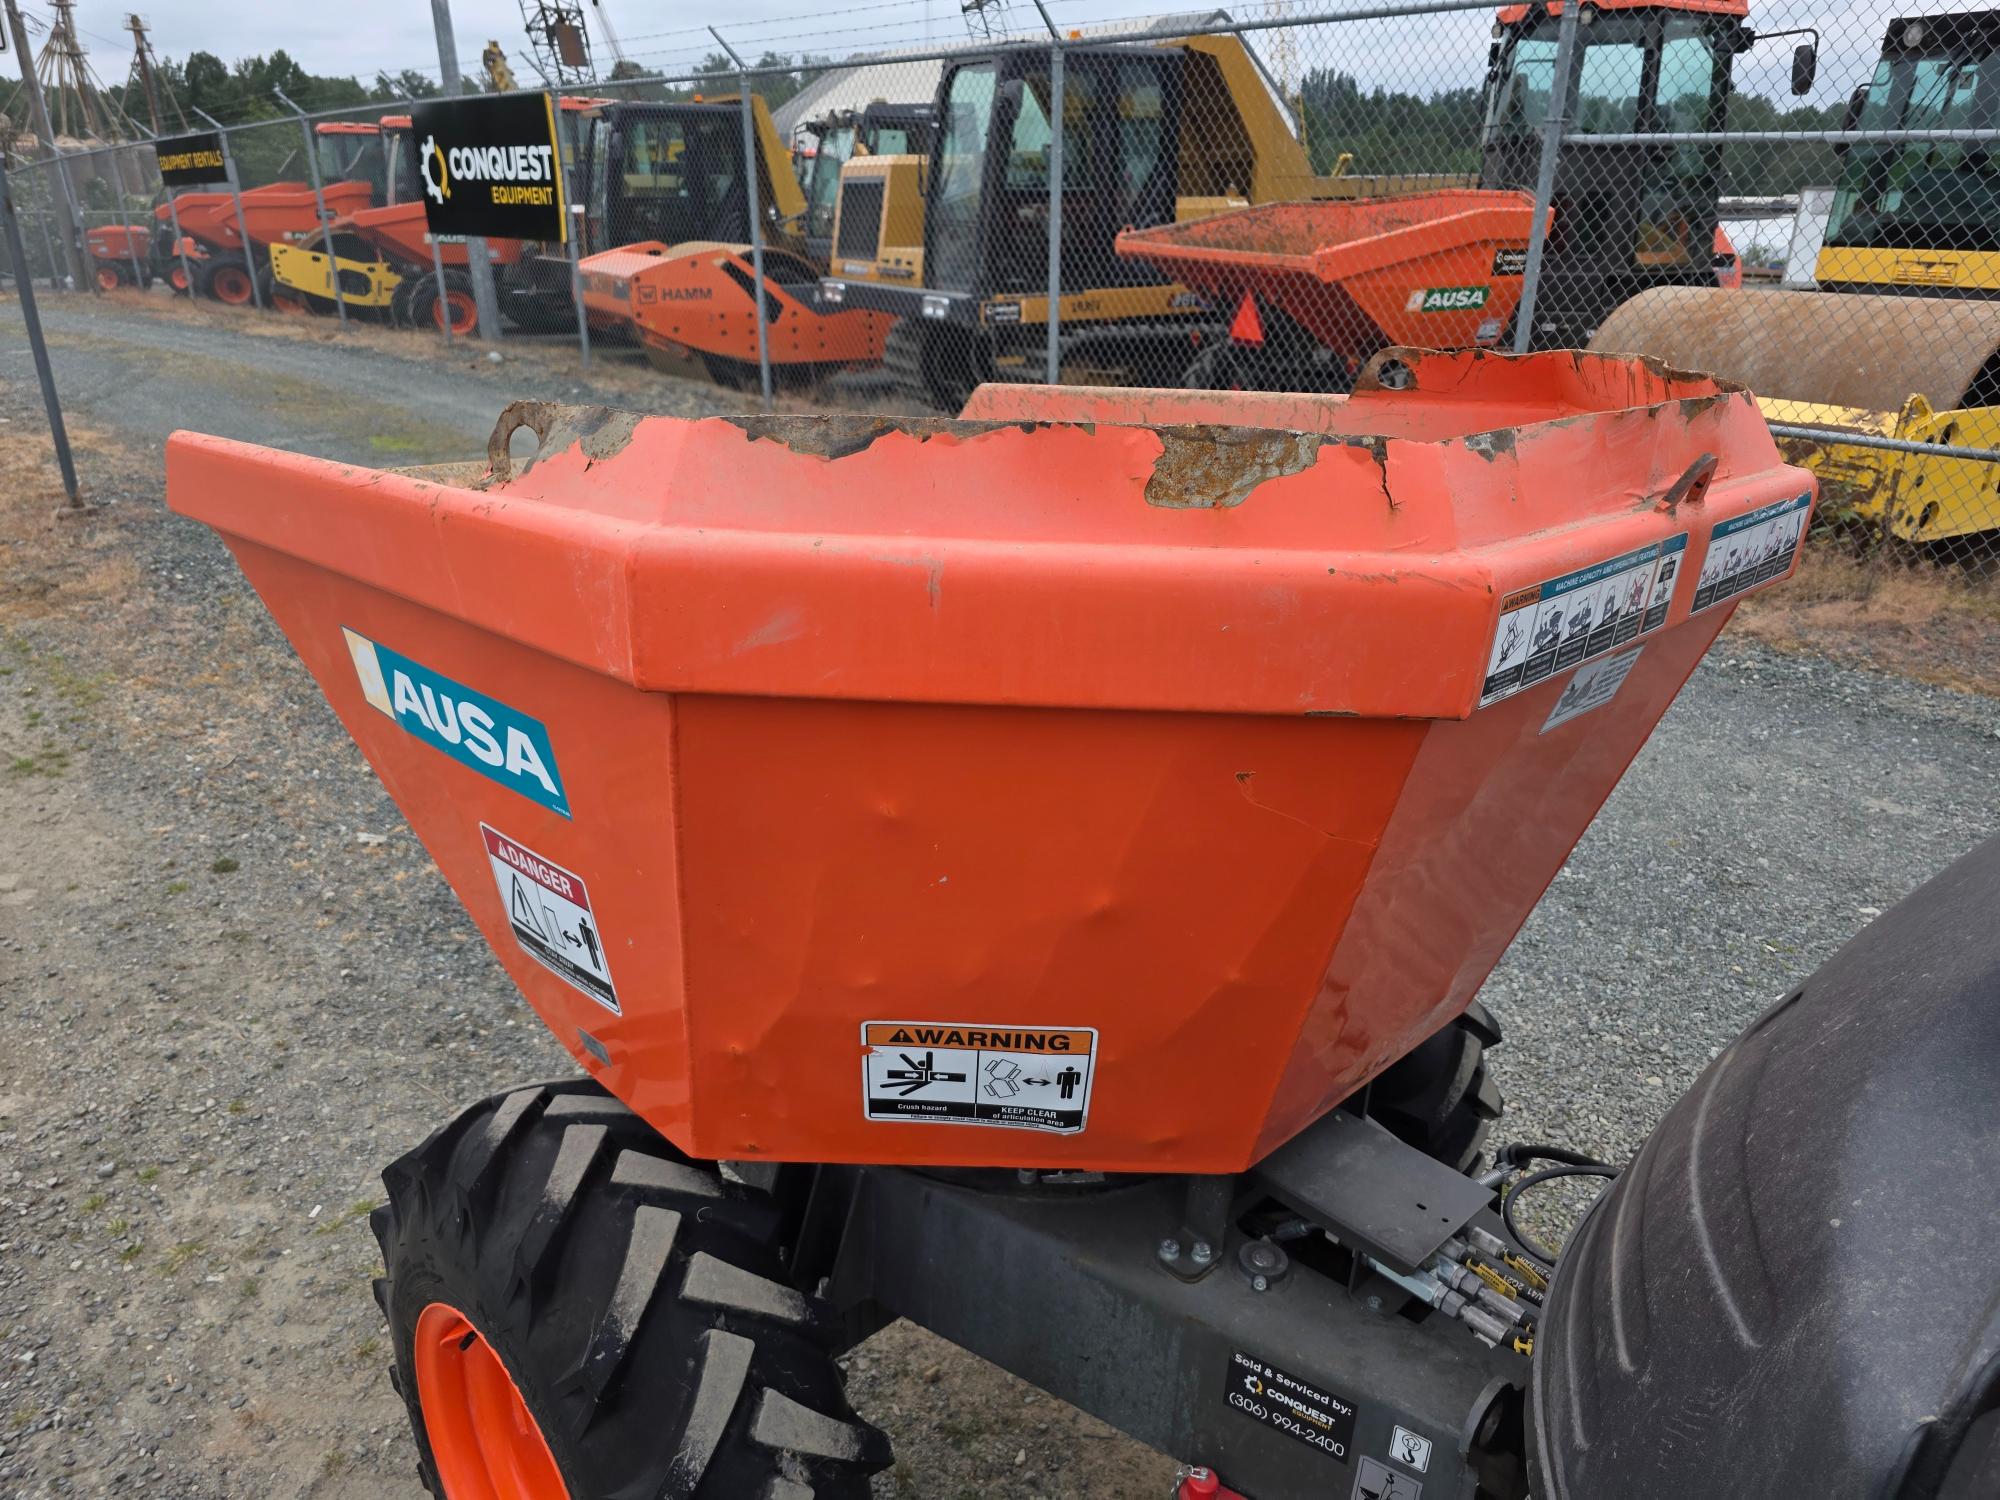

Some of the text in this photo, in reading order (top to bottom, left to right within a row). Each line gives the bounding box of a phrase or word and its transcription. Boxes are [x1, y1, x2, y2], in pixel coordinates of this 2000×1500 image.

[193, 150, 224, 168] RENTALS
[449, 145, 552, 180] CONQUEST
[490, 186, 553, 205] EQUIPMENT
[662, 287, 713, 300] HAMM
[1424, 290, 1484, 307] AUSA
[1508, 589, 1540, 609] WARNING
[394, 669, 560, 797] AUSA
[507, 844, 574, 899] DANGER
[915, 1028, 1070, 1051] WARNING
[897, 1103, 948, 1112] Crush hazard
[1001, 1106, 1057, 1119] KEEP CLEAR
[1002, 1113, 1045, 1124] articulation
[1047, 1119, 1065, 1128] area
[1235, 1353, 1352, 1416] Sold & Serviced by:
[1266, 1388, 1336, 1426] CONQUEST
[1229, 1392, 1345, 1456] (306) 994-2400
[1291, 1409, 1332, 1431] EQUIPMENT
